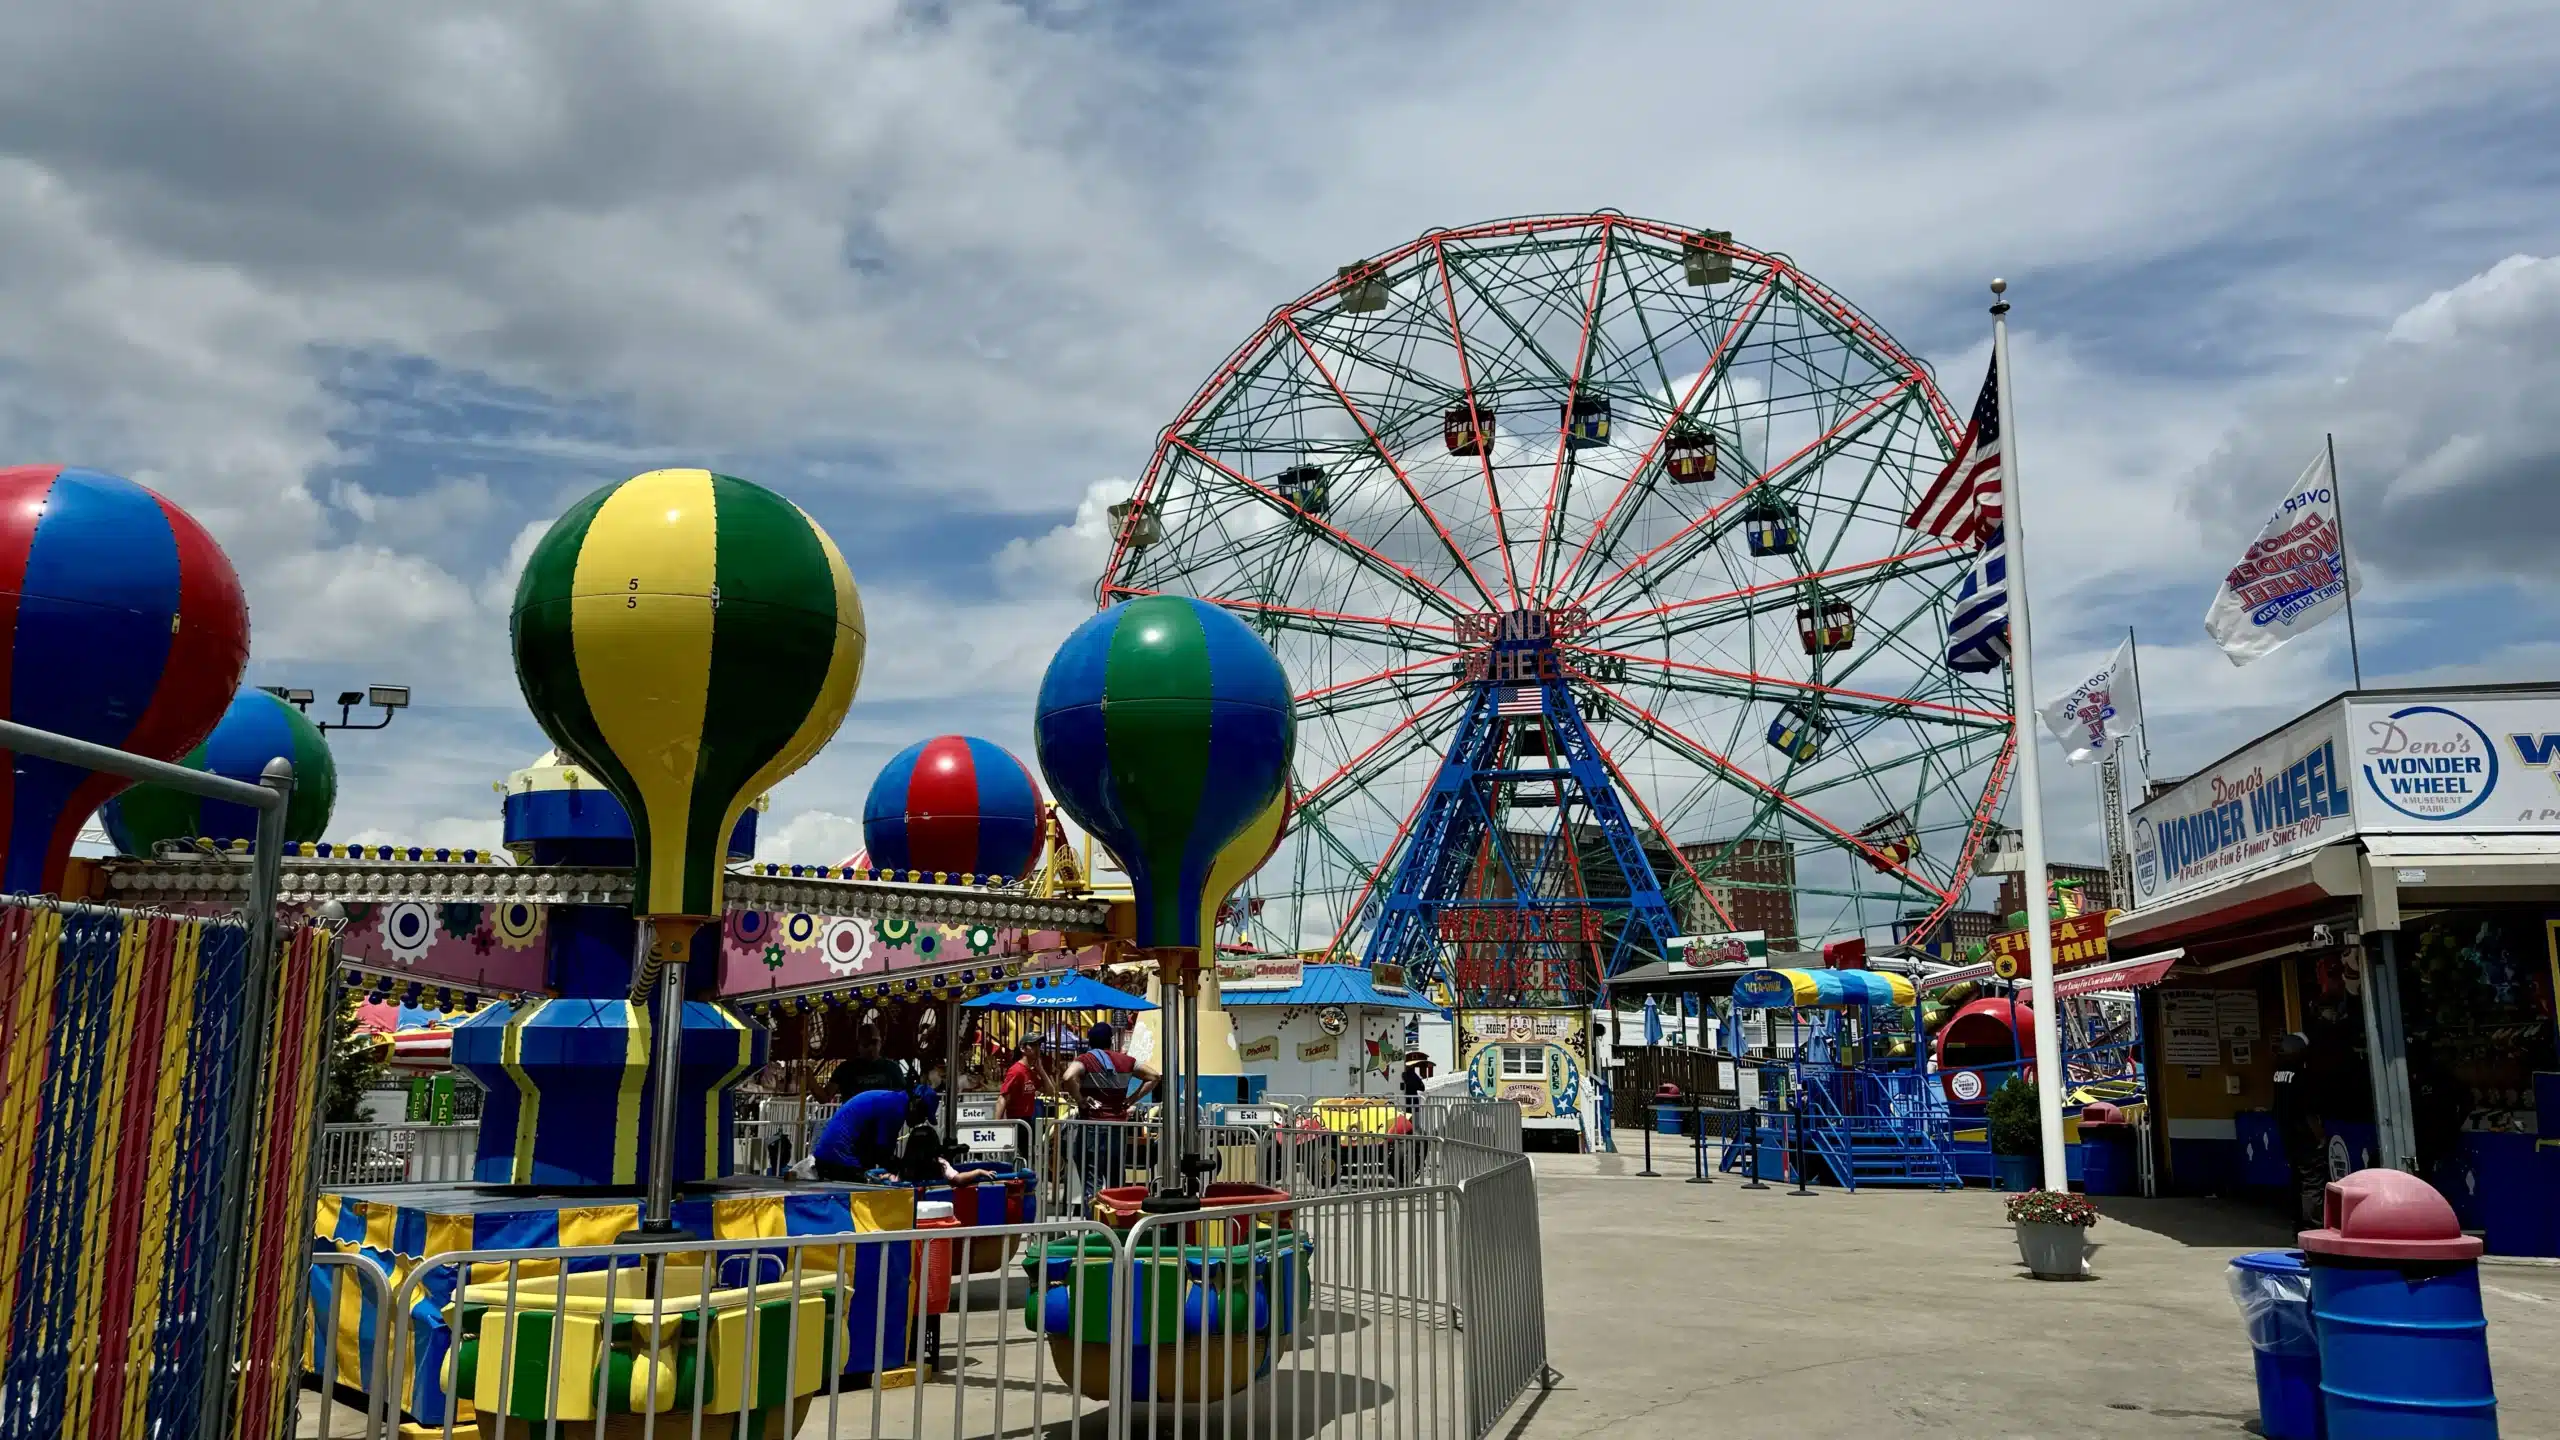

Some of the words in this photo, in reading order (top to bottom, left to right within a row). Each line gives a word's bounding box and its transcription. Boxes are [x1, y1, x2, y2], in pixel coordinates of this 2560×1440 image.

[628, 578, 639, 591] 5
[626, 596, 637, 609] 5
[1453, 607, 1588, 644] WONDER
[1463, 648, 1578, 681] WHEEL
[2366, 720, 2472, 755] Deno's
[2377, 757, 2482, 774] WONDER
[2211, 766, 2263, 808] Deno's
[2390, 777, 2473, 794] WHEEL
[2401, 796, 2463, 804] AMUSEMENT
[2157, 797, 2247, 883] WONDER
[2249, 735, 2350, 837] WHEEL
[2419, 805, 2446, 813] PARK
[2186, 862, 2204, 881] PLACE
[2219, 850, 2234, 868] FUN
[2236, 845, 2242, 863] &
[2243, 838, 2270, 859] FAMILY
[2272, 827, 2297, 847] SINCE
[2300, 813, 2321, 839] 1920
[1438, 910, 1604, 942] WONDER
[1456, 959, 1587, 992] WHEEL
[1037, 995, 1078, 1005] pepsi
[1485, 1024, 1506, 1034] MORE
[1536, 1024, 1558, 1036] RIDES
[1246, 1043, 1272, 1057] Photos
[1304, 1042, 1330, 1057] Tickets
[1551, 1053, 1560, 1090] GAMES
[1508, 1084, 1540, 1092] EXCITEMENT
[413, 1092, 421, 1119] YES
[962, 1109, 986, 1118] Enter
[1240, 1111, 1258, 1120] Exit
[973, 1130, 996, 1142] Exit
